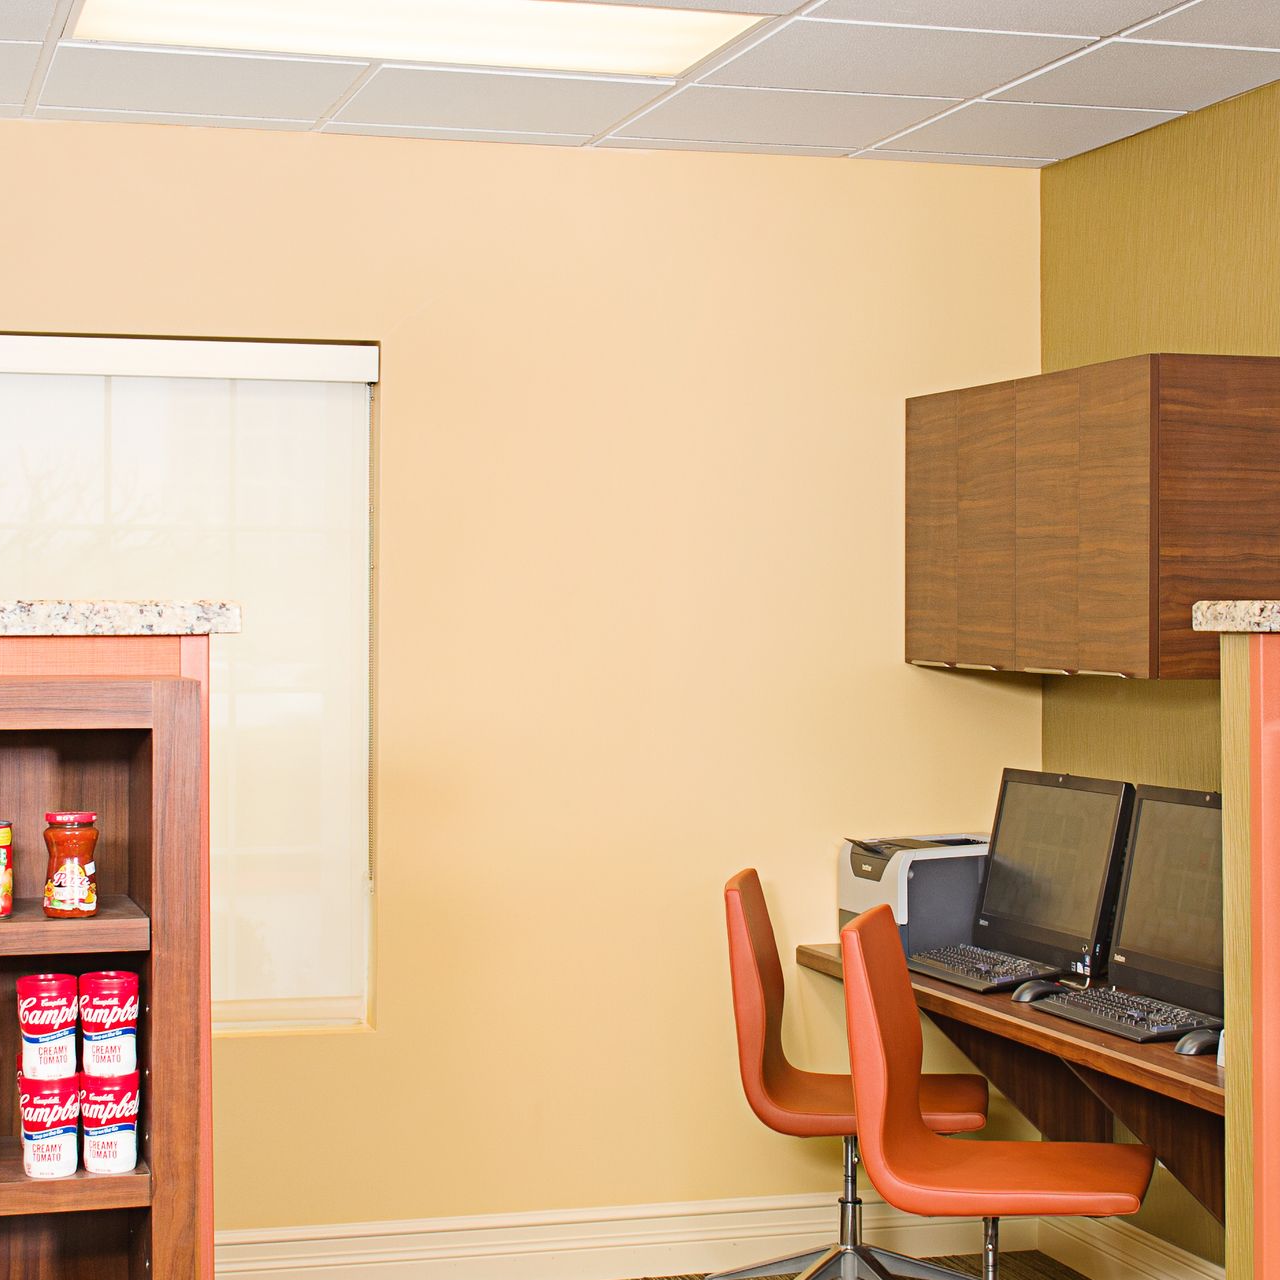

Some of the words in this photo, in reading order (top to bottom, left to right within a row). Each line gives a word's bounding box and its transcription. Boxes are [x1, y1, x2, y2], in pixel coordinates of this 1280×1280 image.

[38, 1045, 68, 1056] CREAMY
[91, 1044, 122, 1055] CREAMY
[39, 1055, 68, 1065] TOMATO
[91, 1054, 122, 1064] TOMATO
[32, 1143, 62, 1154] CREAMY
[88, 1140, 118, 1150] CREAMY
[32, 1152, 62, 1163] TOMATO
[88, 1149, 118, 1159] TOMATO
